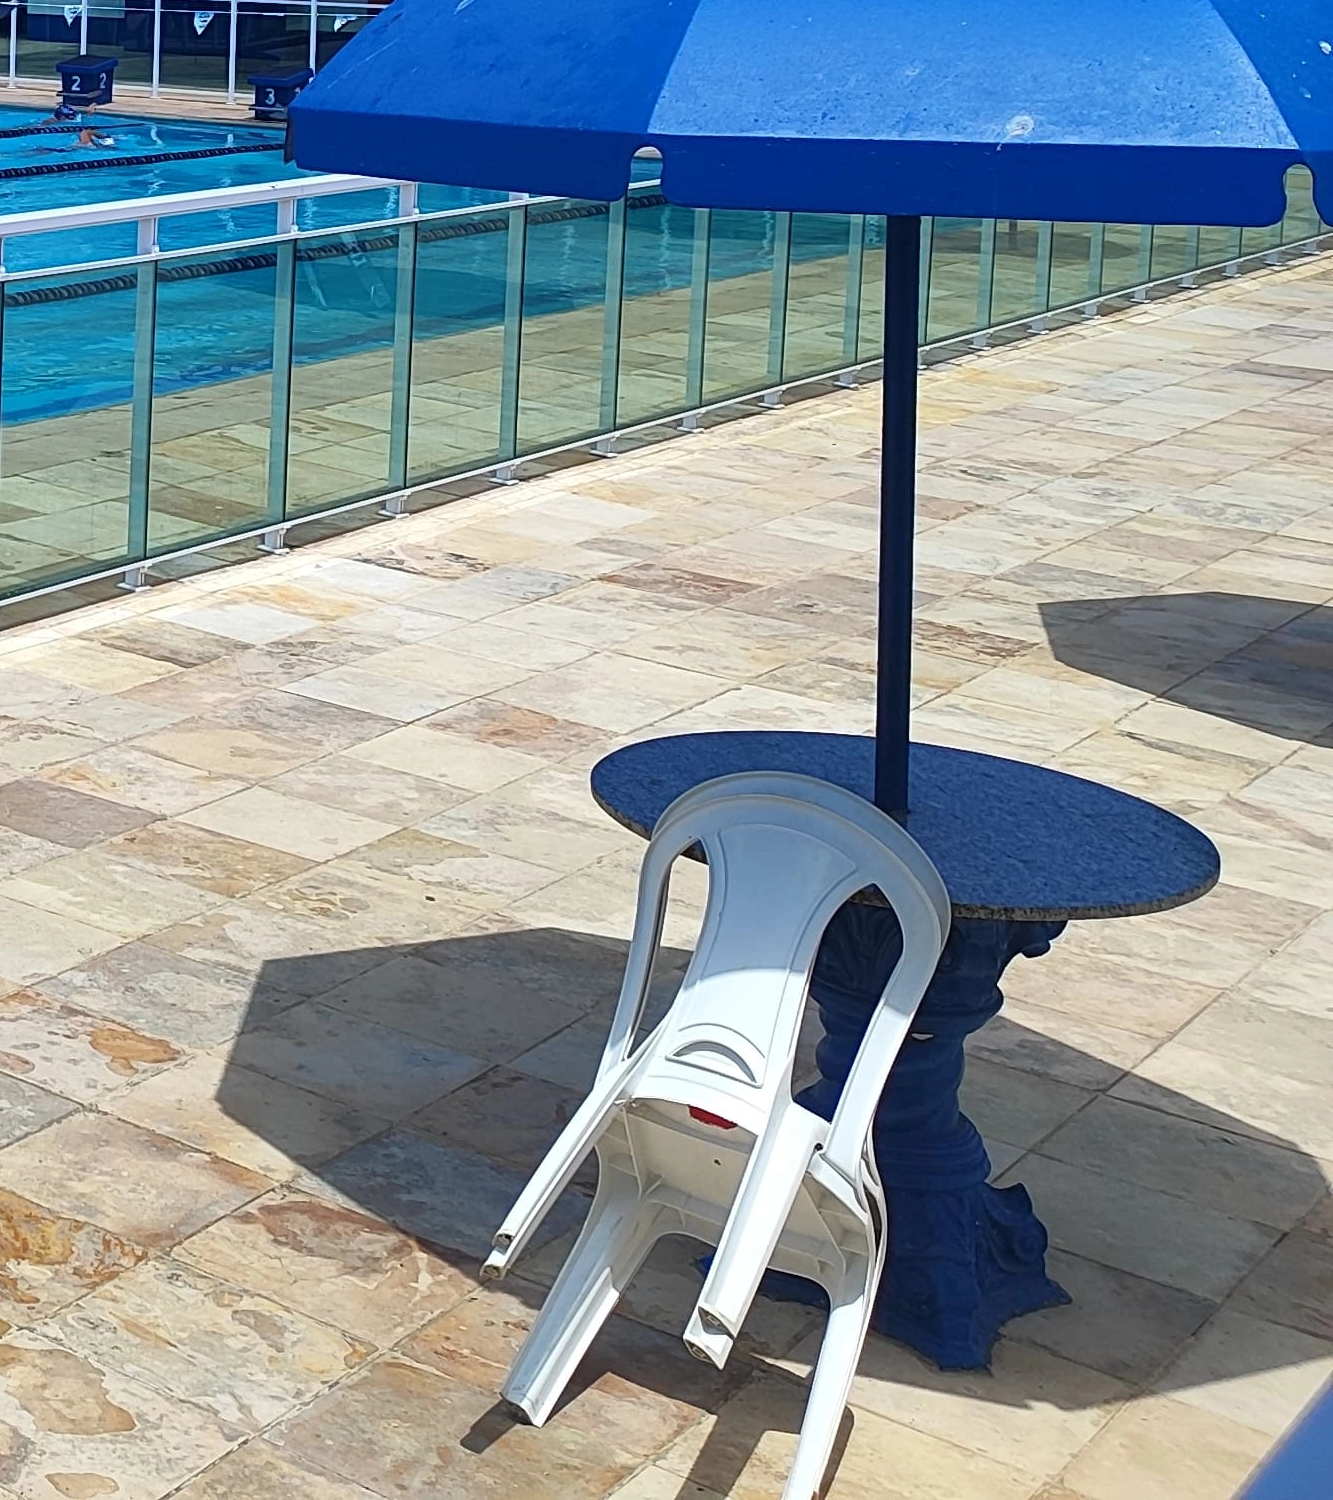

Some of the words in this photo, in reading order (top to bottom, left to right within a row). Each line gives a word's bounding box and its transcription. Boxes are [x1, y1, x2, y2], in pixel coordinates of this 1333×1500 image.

[71, 75, 81, 91] 2
[100, 72, 107, 89] 2
[265, 88, 275, 105] 3
